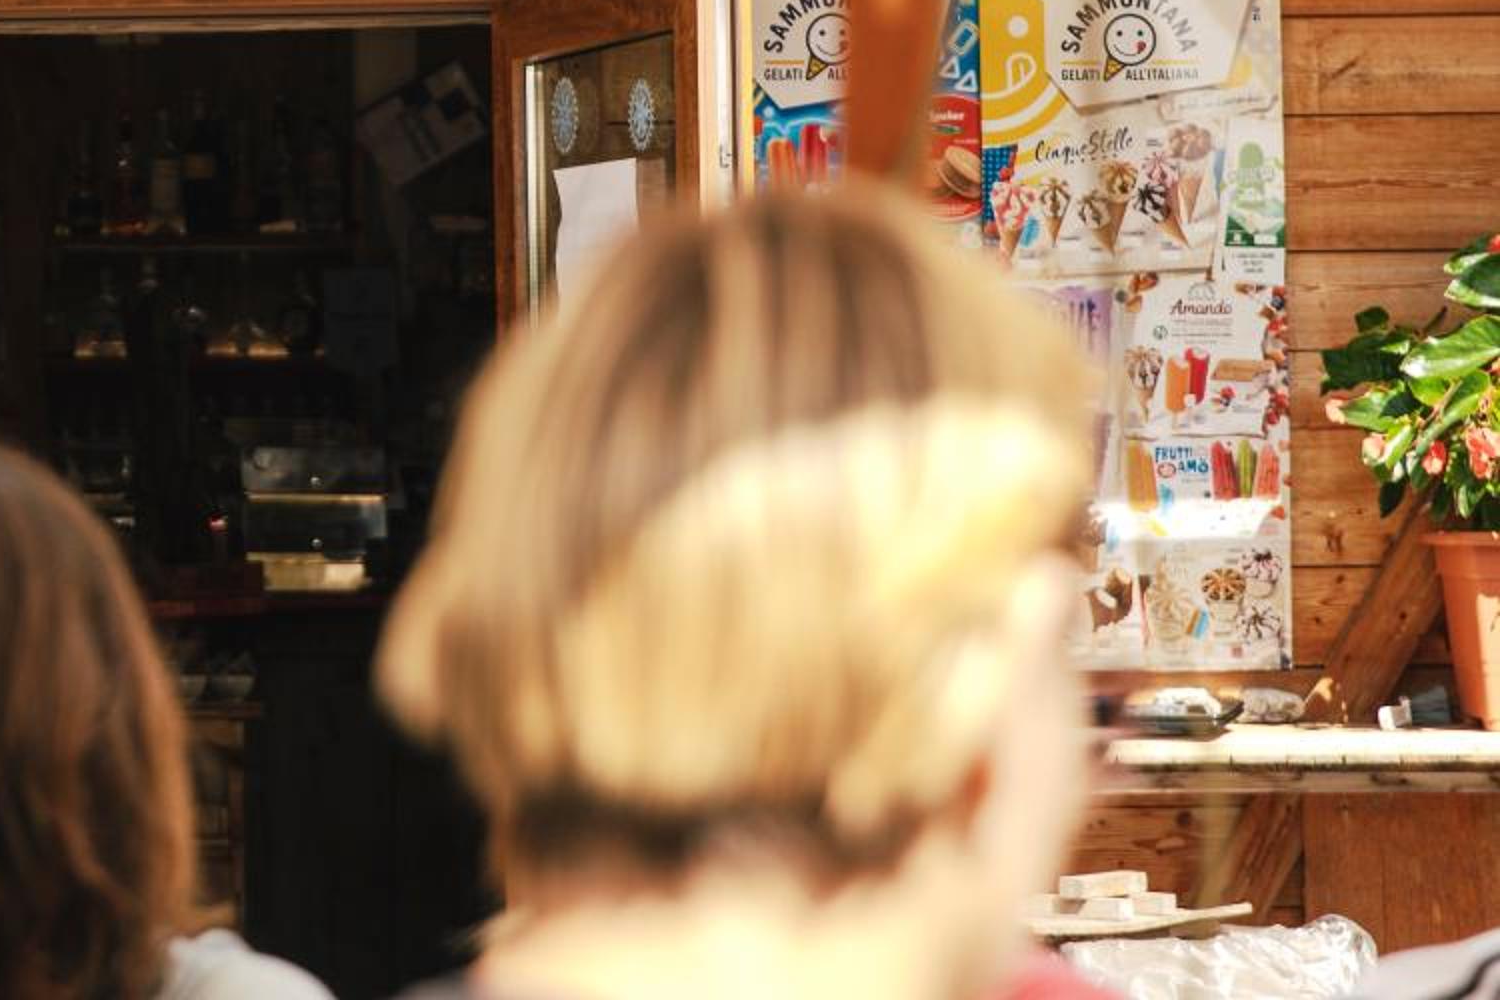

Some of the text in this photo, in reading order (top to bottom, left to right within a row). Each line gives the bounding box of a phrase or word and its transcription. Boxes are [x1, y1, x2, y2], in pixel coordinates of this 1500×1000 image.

[763, 67, 804, 81] GELATI
[1060, 66, 1199, 81] GELATI ALL'ITALIANA
